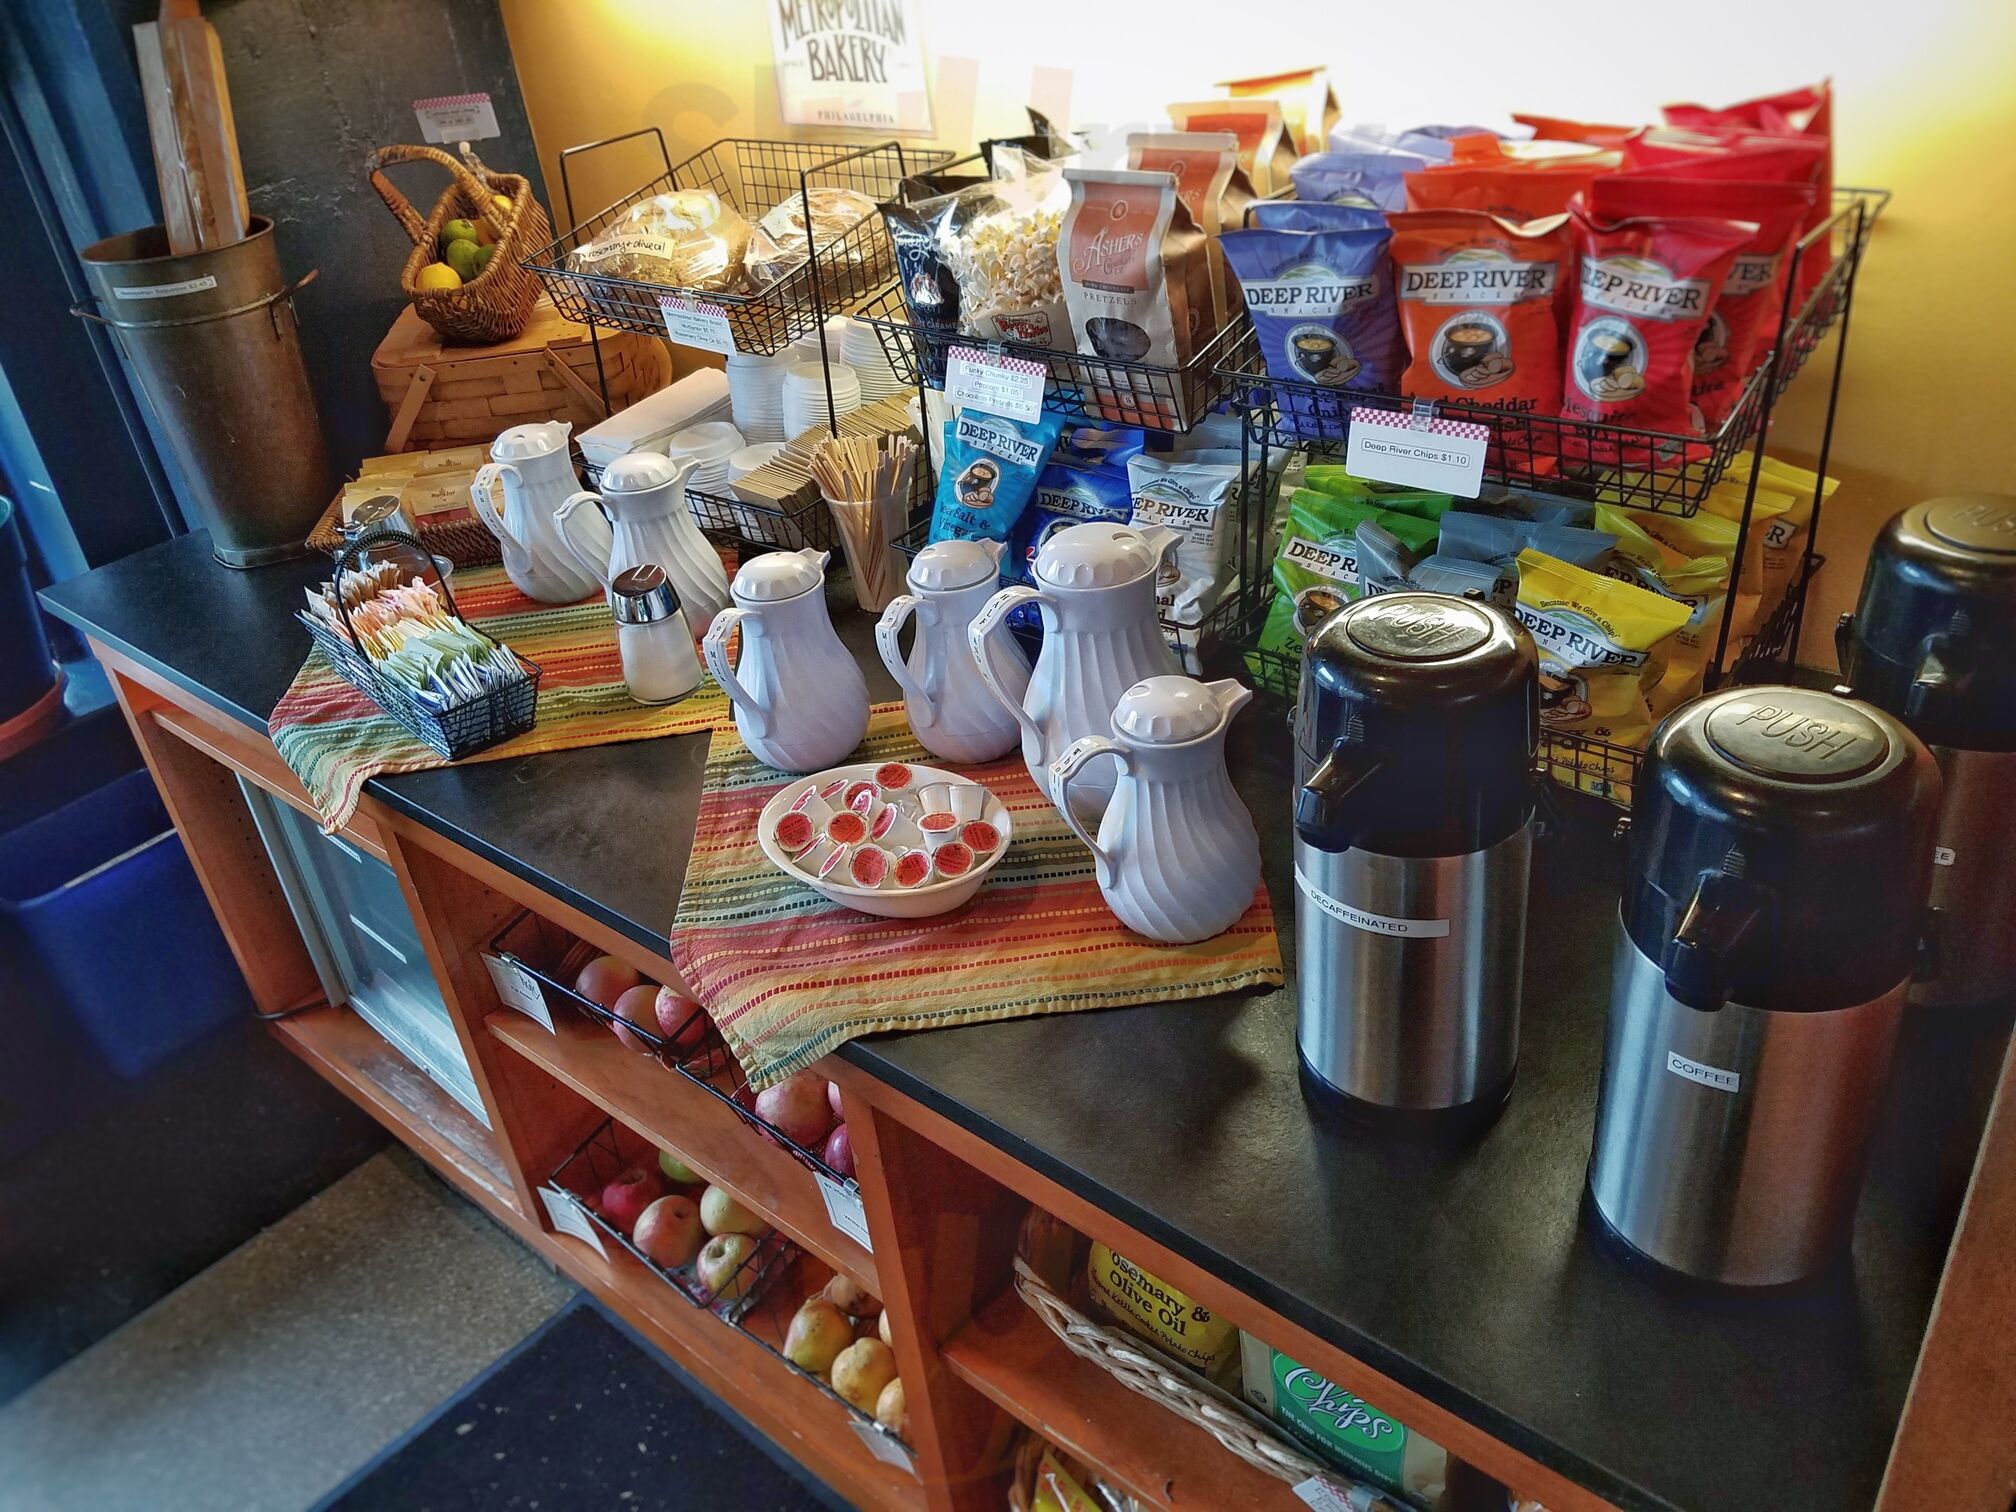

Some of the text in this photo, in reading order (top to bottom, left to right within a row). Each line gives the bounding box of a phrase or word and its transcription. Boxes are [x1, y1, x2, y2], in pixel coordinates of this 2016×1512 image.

[806, 34, 888, 83] BAKERY
[817, 110, 895, 124] PHILADELPHIA
[1245, 282, 1373, 305] DEEP RIVER
[1406, 269, 1547, 292] DEEP RIVER
[1623, 278, 1701, 310] RIVER
[1083, 292, 1137, 305] PRETZELS
[964, 365, 984, 375] Funky
[985, 369, 1009, 381] Chunky
[974, 380, 1000, 392] Popcorn
[959, 421, 1039, 462] DEEP RIVER
[1364, 441, 1467, 465] Deep River Chips $1.10
[1041, 492, 1080, 511] DEEP
[1155, 502, 1209, 522] RIVER
[954, 507, 977, 527] Salt
[1135, 512, 1188, 526] NACKS
[1288, 541, 1341, 567] DEEP
[979, 594, 1009, 625] HALF
[1540, 600, 1569, 608] Because
[1571, 601, 1583, 610] We
[1583, 606, 1598, 618] Give
[1373, 603, 1467, 645] PUSH
[1513, 608, 1566, 641] DEEP
[1542, 638, 1589, 666] NACK
[1736, 704, 1858, 760] PUSH
[1311, 890, 1408, 932] DECAFFEINATED
[1672, 1059, 1734, 1086] COFFEE
[1110, 1250, 1186, 1317] osemary
[1191, 1306, 1210, 1323] &
[1109, 1270, 1153, 1313] Olive
[1158, 1308, 1187, 1337] Oil
[1160, 1333, 1187, 1355] Potato
[1187, 1350, 1216, 1367] Chips
[1280, 1405, 1296, 1423] THE
[1297, 1419, 1315, 1436] CHIP
[1316, 1432, 1333, 1448] FOR
